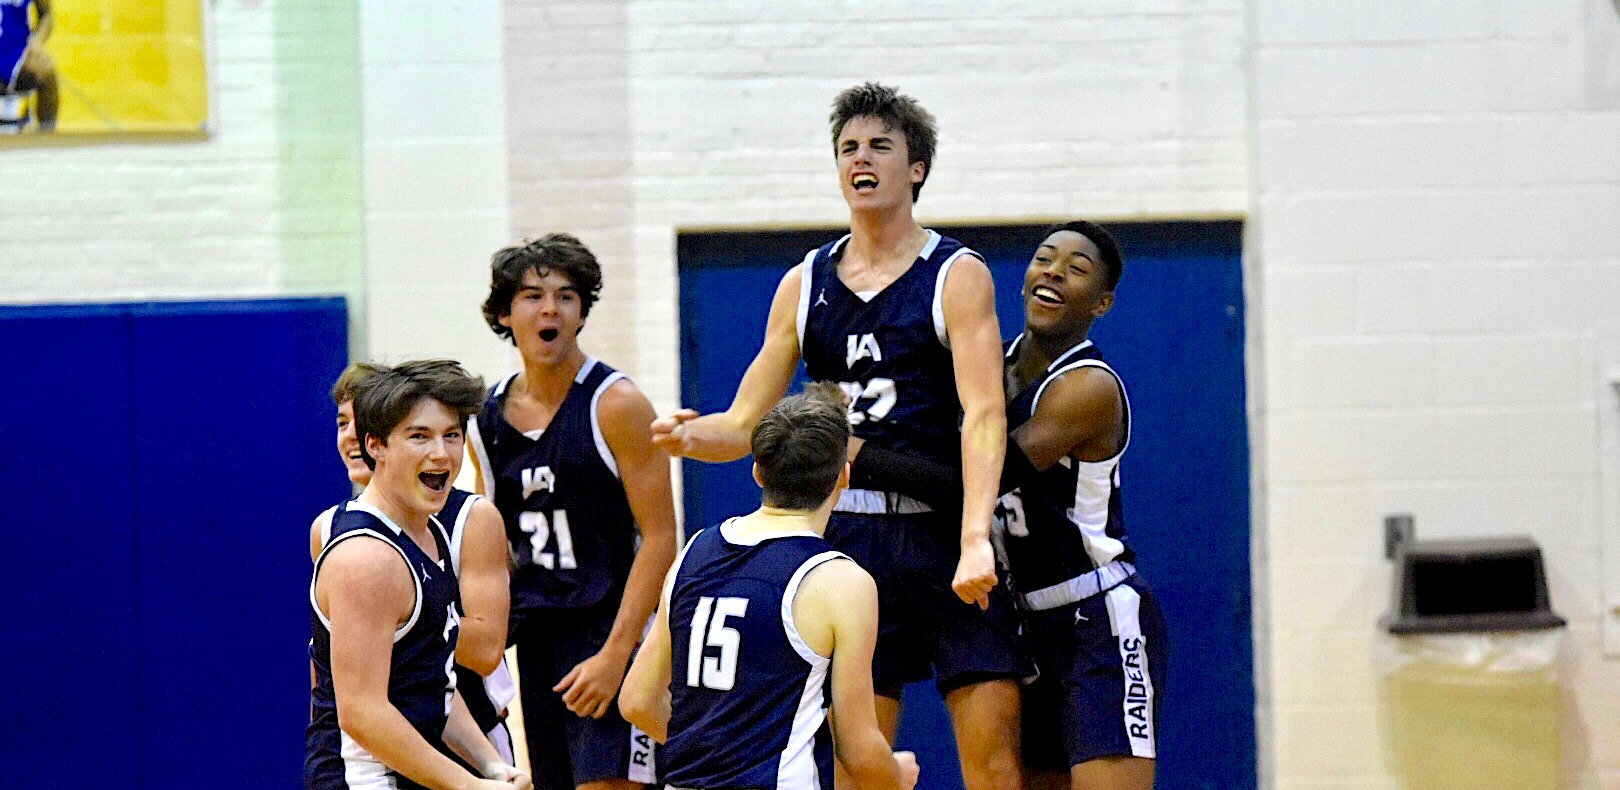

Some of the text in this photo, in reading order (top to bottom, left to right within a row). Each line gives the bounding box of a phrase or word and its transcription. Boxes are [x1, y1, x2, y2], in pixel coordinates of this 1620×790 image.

[519, 508, 578, 570] 21
[686, 595, 750, 691] 15
[1123, 637, 1149, 740] RAIDERS
